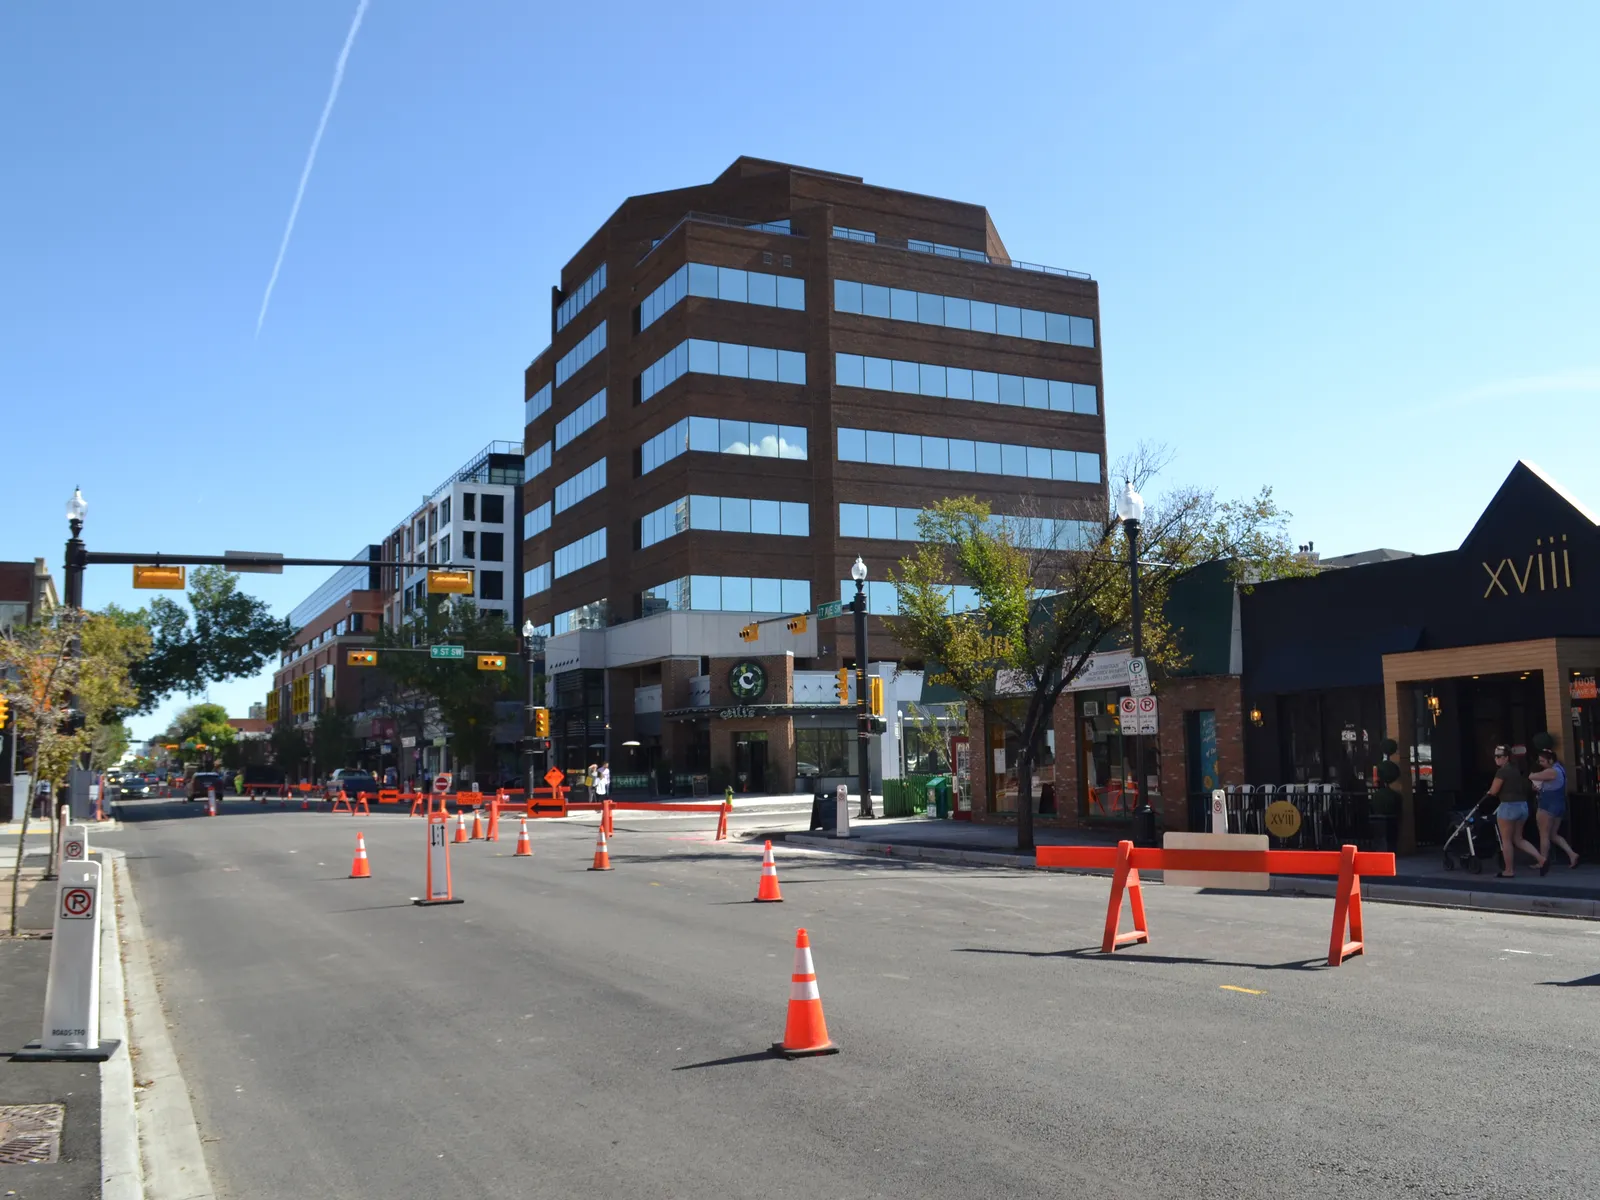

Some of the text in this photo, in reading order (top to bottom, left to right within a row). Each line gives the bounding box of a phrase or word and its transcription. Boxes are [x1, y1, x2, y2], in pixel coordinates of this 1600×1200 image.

[432, 648, 462, 656] 9 ST SW
